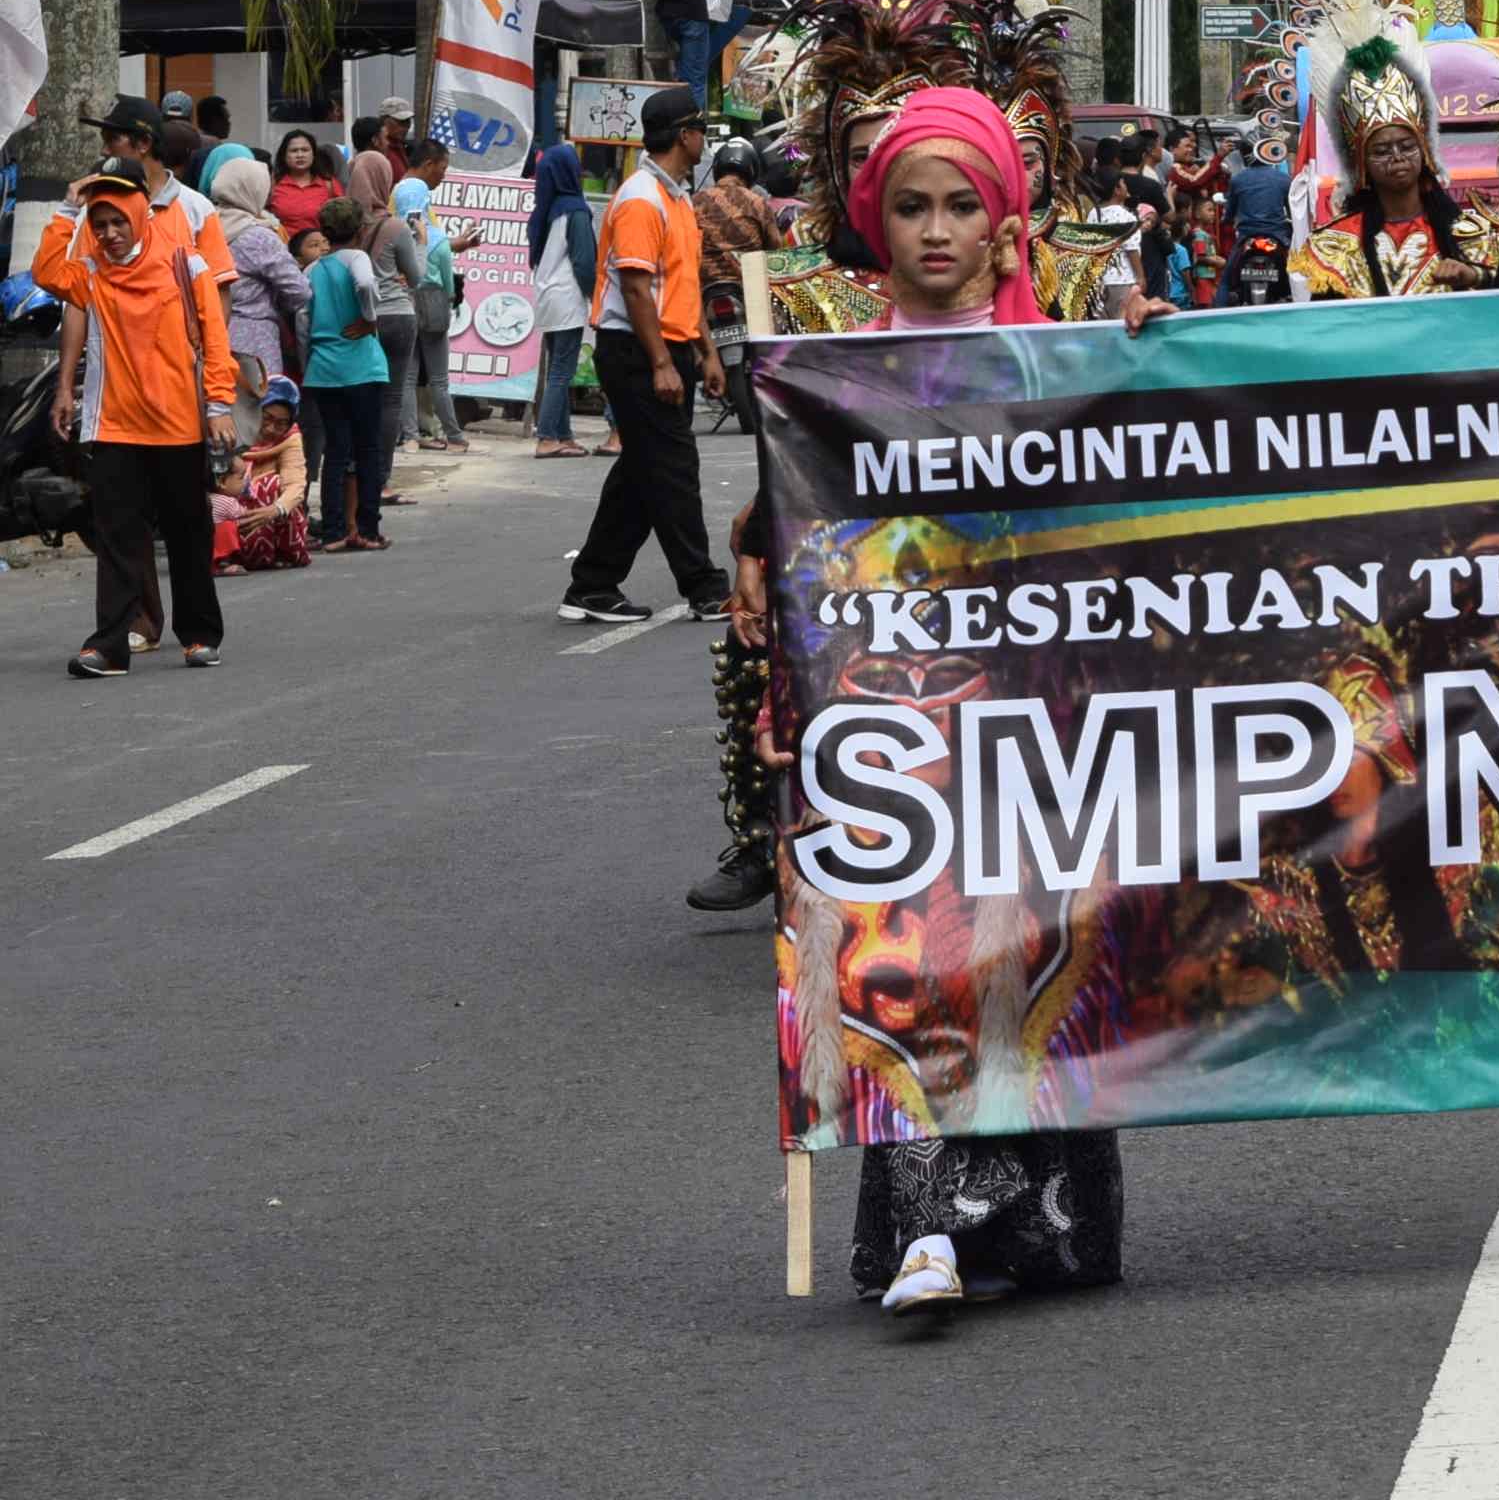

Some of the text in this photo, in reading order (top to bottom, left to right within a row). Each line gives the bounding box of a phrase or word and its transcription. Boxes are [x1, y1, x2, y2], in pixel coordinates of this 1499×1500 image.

[464, 184, 519, 212] AYAM
[521, 191, 536, 212] &
[852, 419, 1232, 496] MENCINTAI
[793, 680, 1355, 902] SMP
